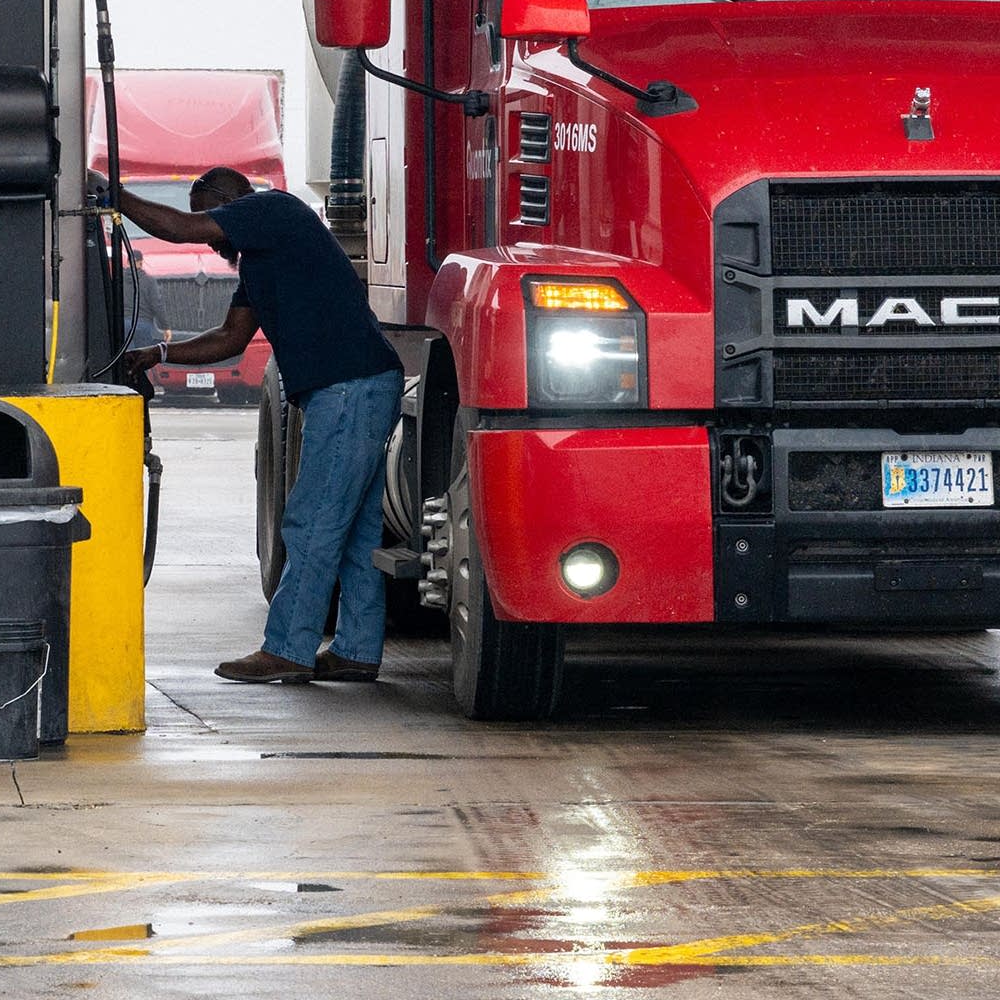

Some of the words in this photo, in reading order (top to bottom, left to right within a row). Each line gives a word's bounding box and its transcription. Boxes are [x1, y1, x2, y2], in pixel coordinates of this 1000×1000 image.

[554, 122, 597, 152] 3016MS
[787, 297, 1000, 327] MAC
[912, 454, 961, 463] INDIANA
[908, 467, 988, 493] 3374421
